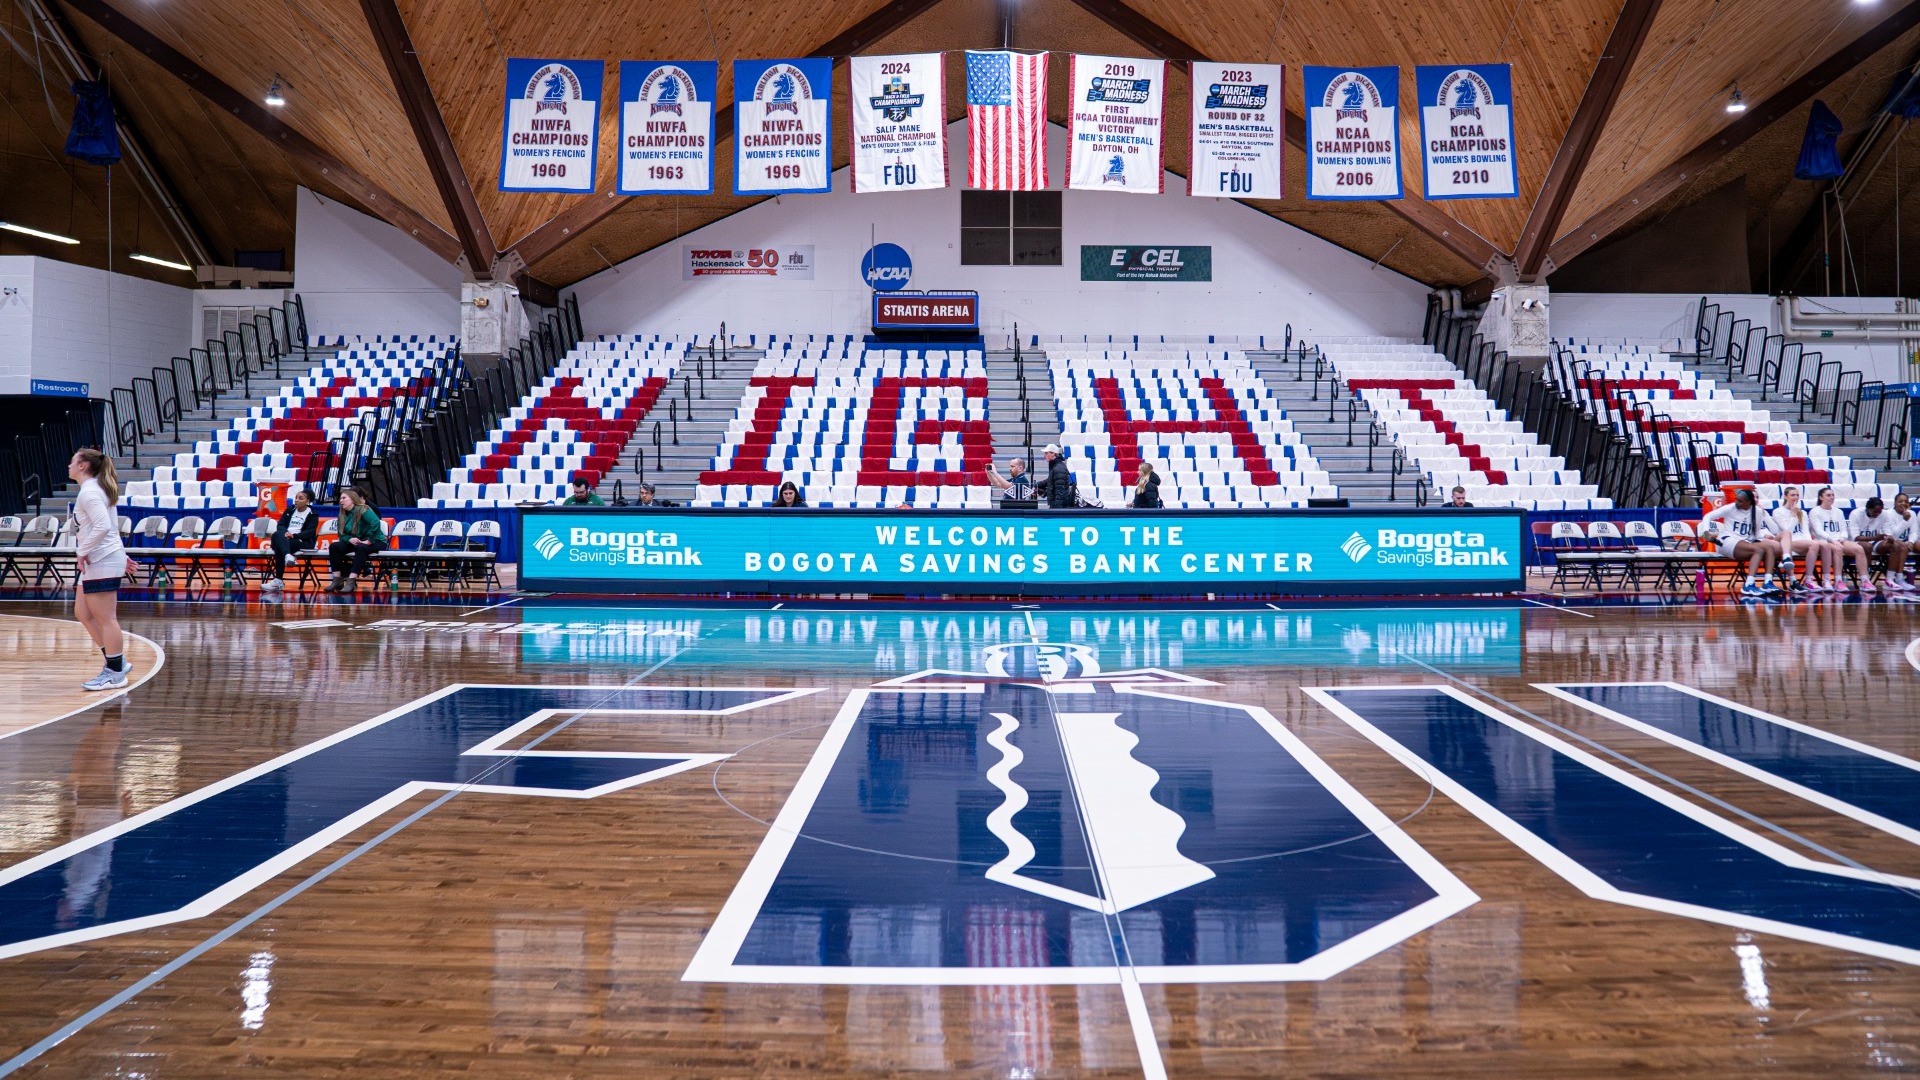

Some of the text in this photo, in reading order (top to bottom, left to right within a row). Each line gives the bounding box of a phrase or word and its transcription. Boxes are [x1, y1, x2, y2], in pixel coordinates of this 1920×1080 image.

[881, 62, 910, 74] 2024
[1105, 64, 1134, 76] 2019
[1222, 71, 1252, 82] 2023
[527, 66, 580, 100] FAIRLEIGH DICKINSON
[640, 68, 695, 102] FAIRLEIGH DICKINSON
[756, 66, 811, 100] FAIRLEIGH DICKINSON
[1102, 80, 1134, 90] MARCH
[1439, 72, 1492, 106] FAIRLEIGH DICKINSON
[1105, 89, 1148, 100] MADNESS
[1220, 86, 1251, 95] MARCH
[1325, 75, 1380, 108] FAIRLEIGH DICKINSON
[874, 98, 920, 106] CHAMPIONSHIPS
[1223, 95, 1266, 105] MADNESS
[1105, 105, 1130, 114] FIRST
[1076, 113, 1158, 126] NCAA TOURNAMENT
[1208, 112, 1237, 120] ROUND
[531, 119, 571, 132] NIWFA
[646, 121, 687, 133] NIWFA
[762, 119, 803, 132] NIWFA
[1098, 125, 1135, 134] VICTORY
[1451, 125, 1484, 137] NCAA
[860, 132, 936, 142] NATIONAL CHAMPION
[1336, 127, 1370, 139] NCAA
[512, 133, 588, 146] CHAMPIONS
[628, 135, 705, 147] CHAMPIONS
[744, 133, 822, 147] CHAMPIONS
[1079, 134, 1154, 145] MEN'S BASKETBALL
[1431, 139, 1506, 151] CHAMPIONS
[1093, 144, 1139, 154] DAYTON, OH
[1316, 141, 1392, 153] CHAMPIONS
[513, 149, 586, 158] WOMEN'S FENCING
[630, 150, 703, 160] WOMEN'S FENCING
[746, 149, 820, 159] WOMEN'S FENCING
[1432, 154, 1506, 164] WOMEN'S BOWLING
[1356, 156, 1391, 164] BOWLING
[532, 164, 566, 178] 1960
[648, 166, 684, 180] 1963
[764, 165, 800, 179] 1969
[884, 164, 916, 185] FDU
[1453, 170, 1489, 184] 2010
[1220, 172, 1252, 193] FDU
[1337, 172, 1373, 185] 2006
[691, 249, 779, 268] TOYOTA 50
[867, 267, 911, 280] NCAA
[884, 305, 969, 316] STRATIS ARENA
[38, 384, 78, 392] Restroom
[261, 488, 272, 501] G
[1714, 499, 1722, 507] G
[1823, 520, 1840, 532] FDU
[570, 528, 678, 550] Bogota
[875, 526, 1184, 546] WELCOME TO THE
[1378, 529, 1484, 552] Bogota
[570, 546, 703, 566] Savings Bank
[1377, 547, 1509, 567] Savings Bank
[745, 552, 1313, 574] BOGOTA SAVINGS BANK CENTER
